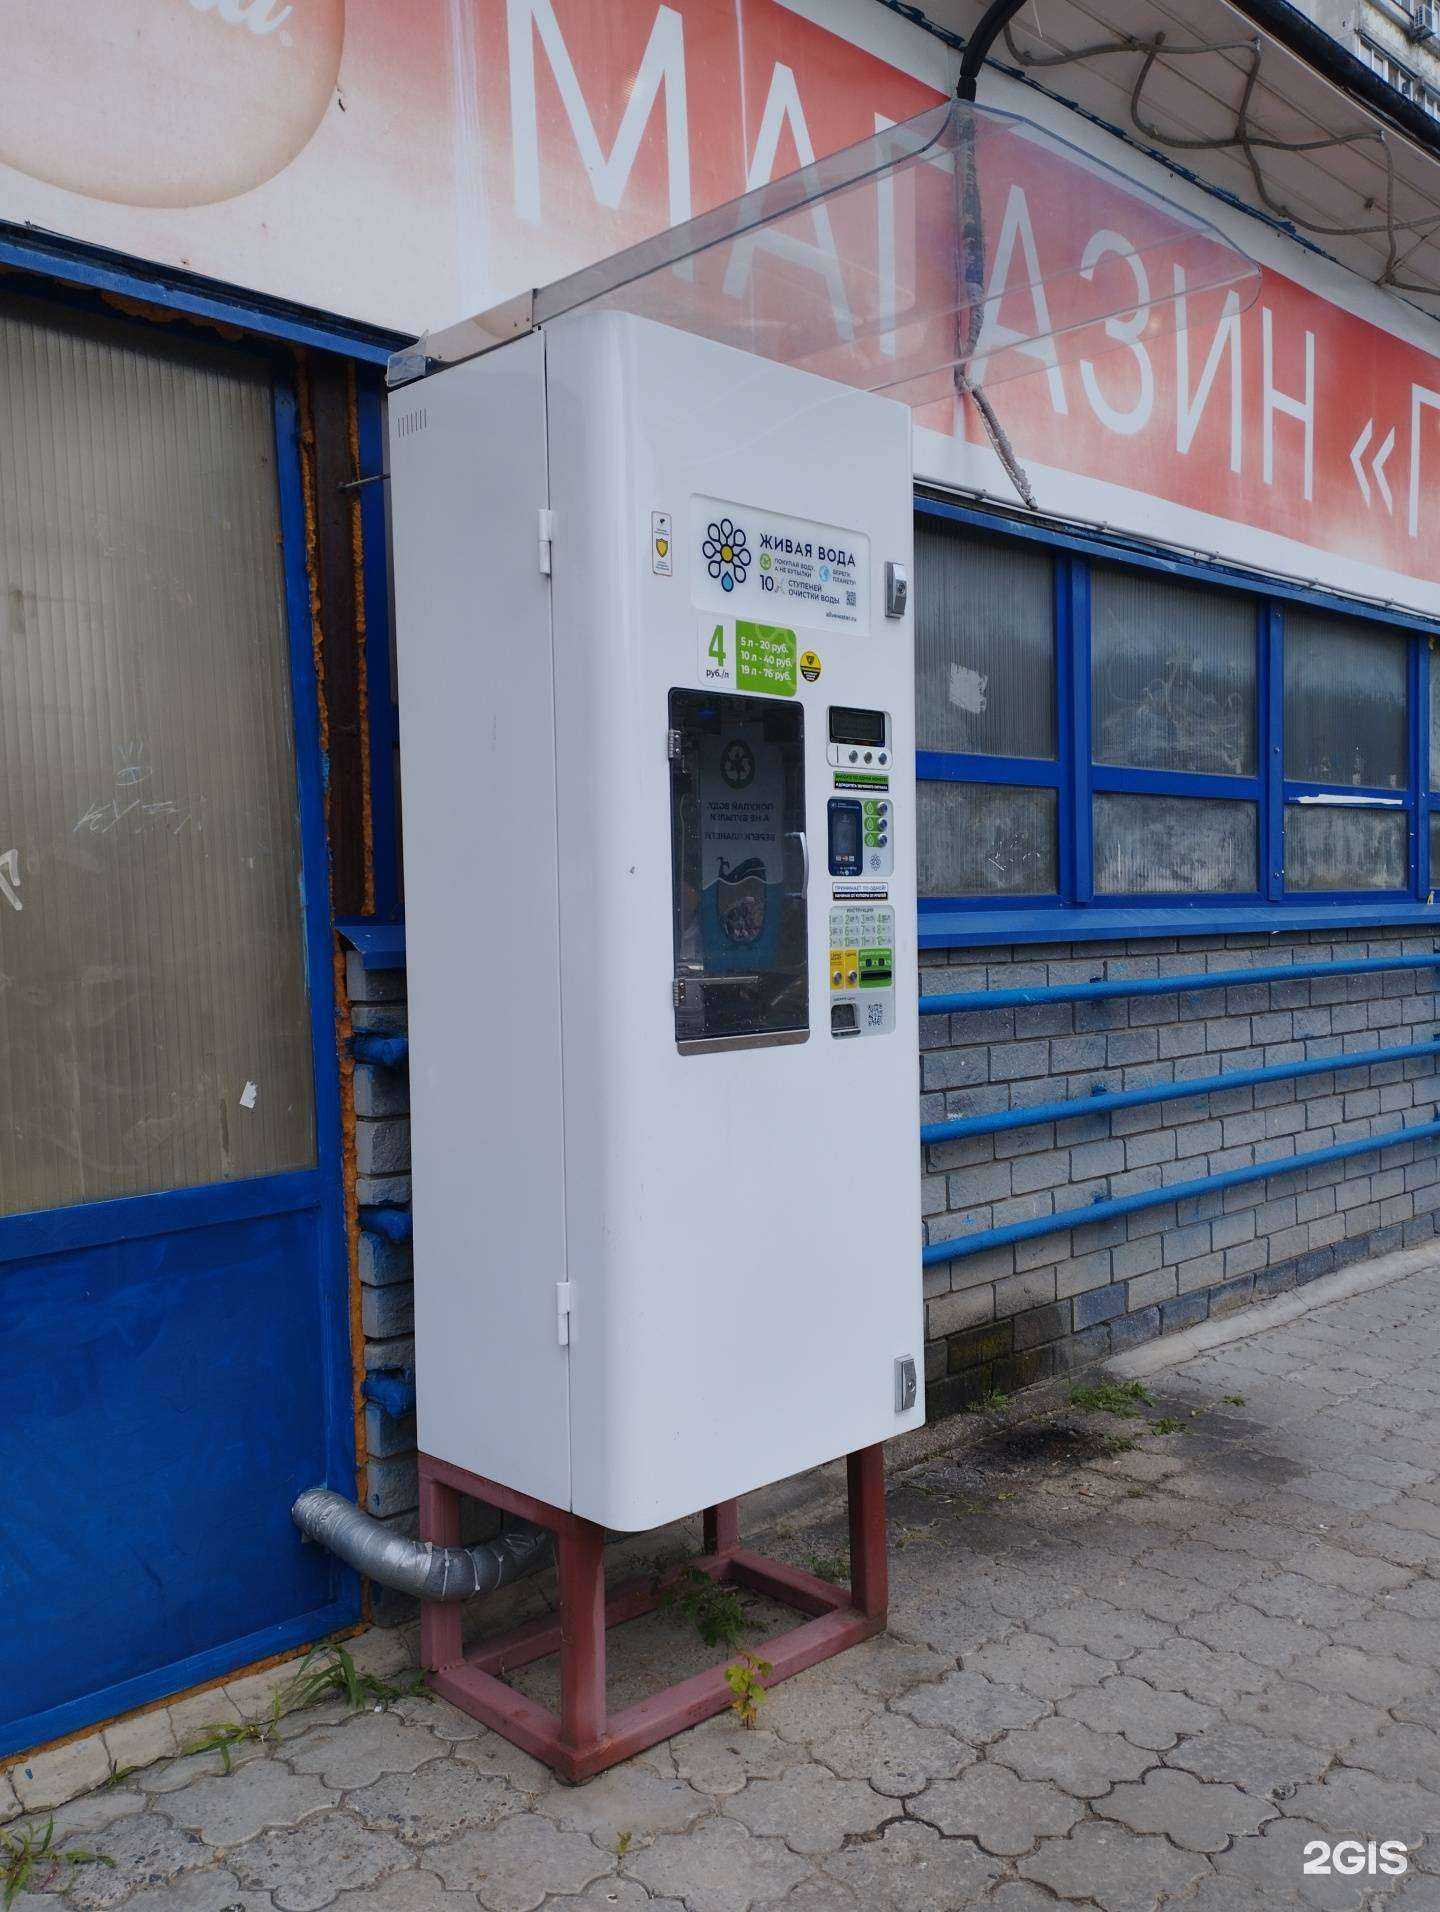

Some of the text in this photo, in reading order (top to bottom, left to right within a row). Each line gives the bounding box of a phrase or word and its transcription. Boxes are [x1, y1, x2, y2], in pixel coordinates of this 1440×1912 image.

[505, 0, 1315, 502] МАГАЗИН
[759, 532, 856, 568] ЖИВАЯ ВОДА
[787, 568, 812, 579] БУТЫЛКИ
[759, 574, 774, 592] 10
[788, 579, 822, 592] СТУПЕНЕЙ
[788, 589, 841, 605] ОЧИСТКИ ВОДЫ
[708, 624, 727, 667] 4
[740, 637, 747, 646] 5
[760, 640, 770, 650] 20
[771, 641, 789, 654] руб.
[741, 650, 750, 660] 10
[751, 653, 757, 661] л
[764, 654, 774, 665] 40
[776, 656, 793, 668] руб.
[706, 668, 730, 680] руб./л
[741, 664, 750, 674] 19
[751, 667, 757, 675] л
[764, 668, 774, 678] 76
[775, 669, 792, 681] руб.
